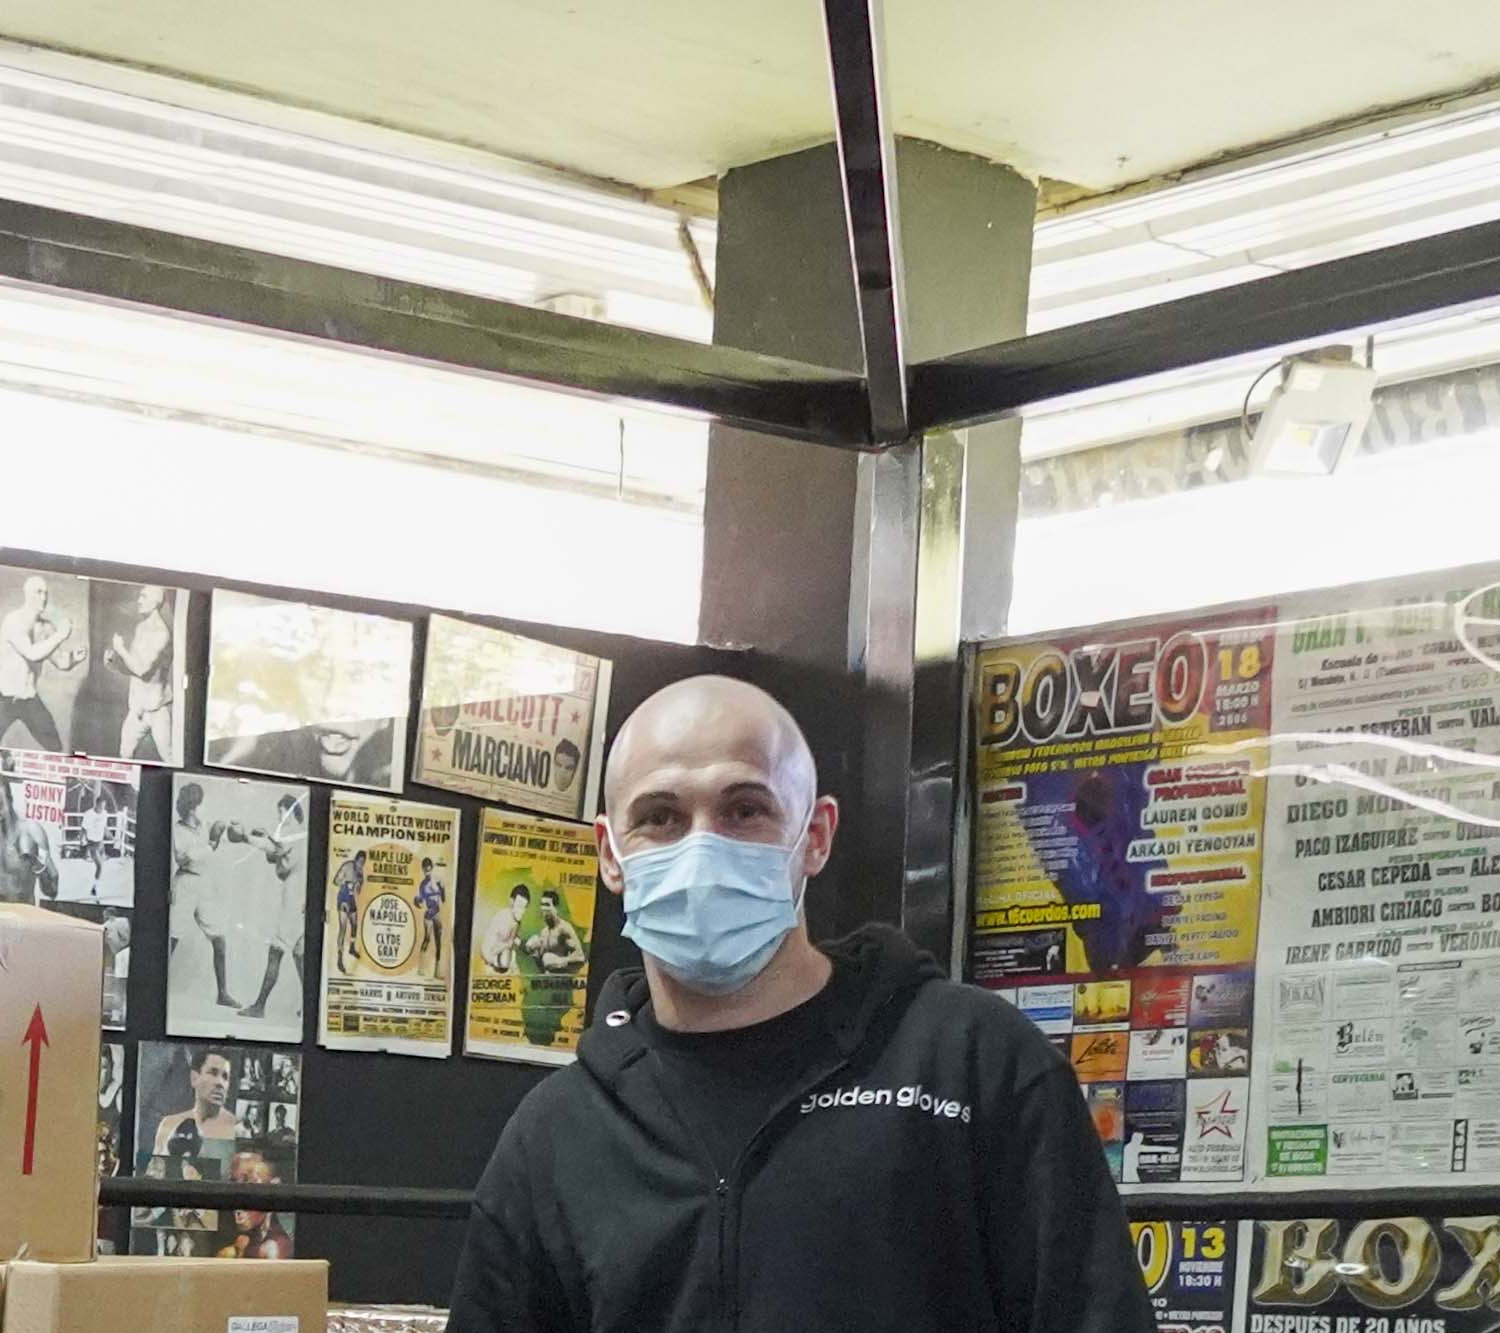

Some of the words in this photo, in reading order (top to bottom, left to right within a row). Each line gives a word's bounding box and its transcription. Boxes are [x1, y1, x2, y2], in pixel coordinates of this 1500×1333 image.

[1217, 645, 1262, 680] 18
[979, 630, 1209, 747] BOXEO
[1216, 680, 1261, 698] MARZO
[451, 729, 551, 790] MARCIANO
[24, 783, 64, 803] SONNY
[25, 803, 66, 824] LISTON
[333, 809, 369, 824] WORLD
[375, 811, 452, 831] WELTERWEIGHT
[1144, 806, 1197, 826] LAUREN
[1287, 800, 1349, 824] DIEGO
[333, 823, 450, 844] CHAMPIONSHIP
[1295, 834, 1330, 859] PACO
[1335, 826, 1418, 854] IZAGUIRRE
[369, 850, 394, 862] MAPLE
[395, 852, 414, 863] LEAF
[1129, 839, 1181, 859] ARKADI
[1318, 872, 1365, 892] CESAR
[1371, 863, 1432, 887] CEPEDA
[380, 899, 399, 910] JOSE
[1311, 905, 1375, 928] AMBIORI
[1380, 897, 1443, 922] CIRIACO
[369, 909, 407, 923] NAPOLES
[376, 933, 401, 946] CLYDE
[377, 944, 399, 958] GRAY
[1286, 942, 1332, 965] IRENE
[1335, 936, 1401, 960] GARRIDO
[800, 1086, 893, 1114] golden
[896, 1084, 971, 1123] gloves
[1179, 1226, 1226, 1261] 13
